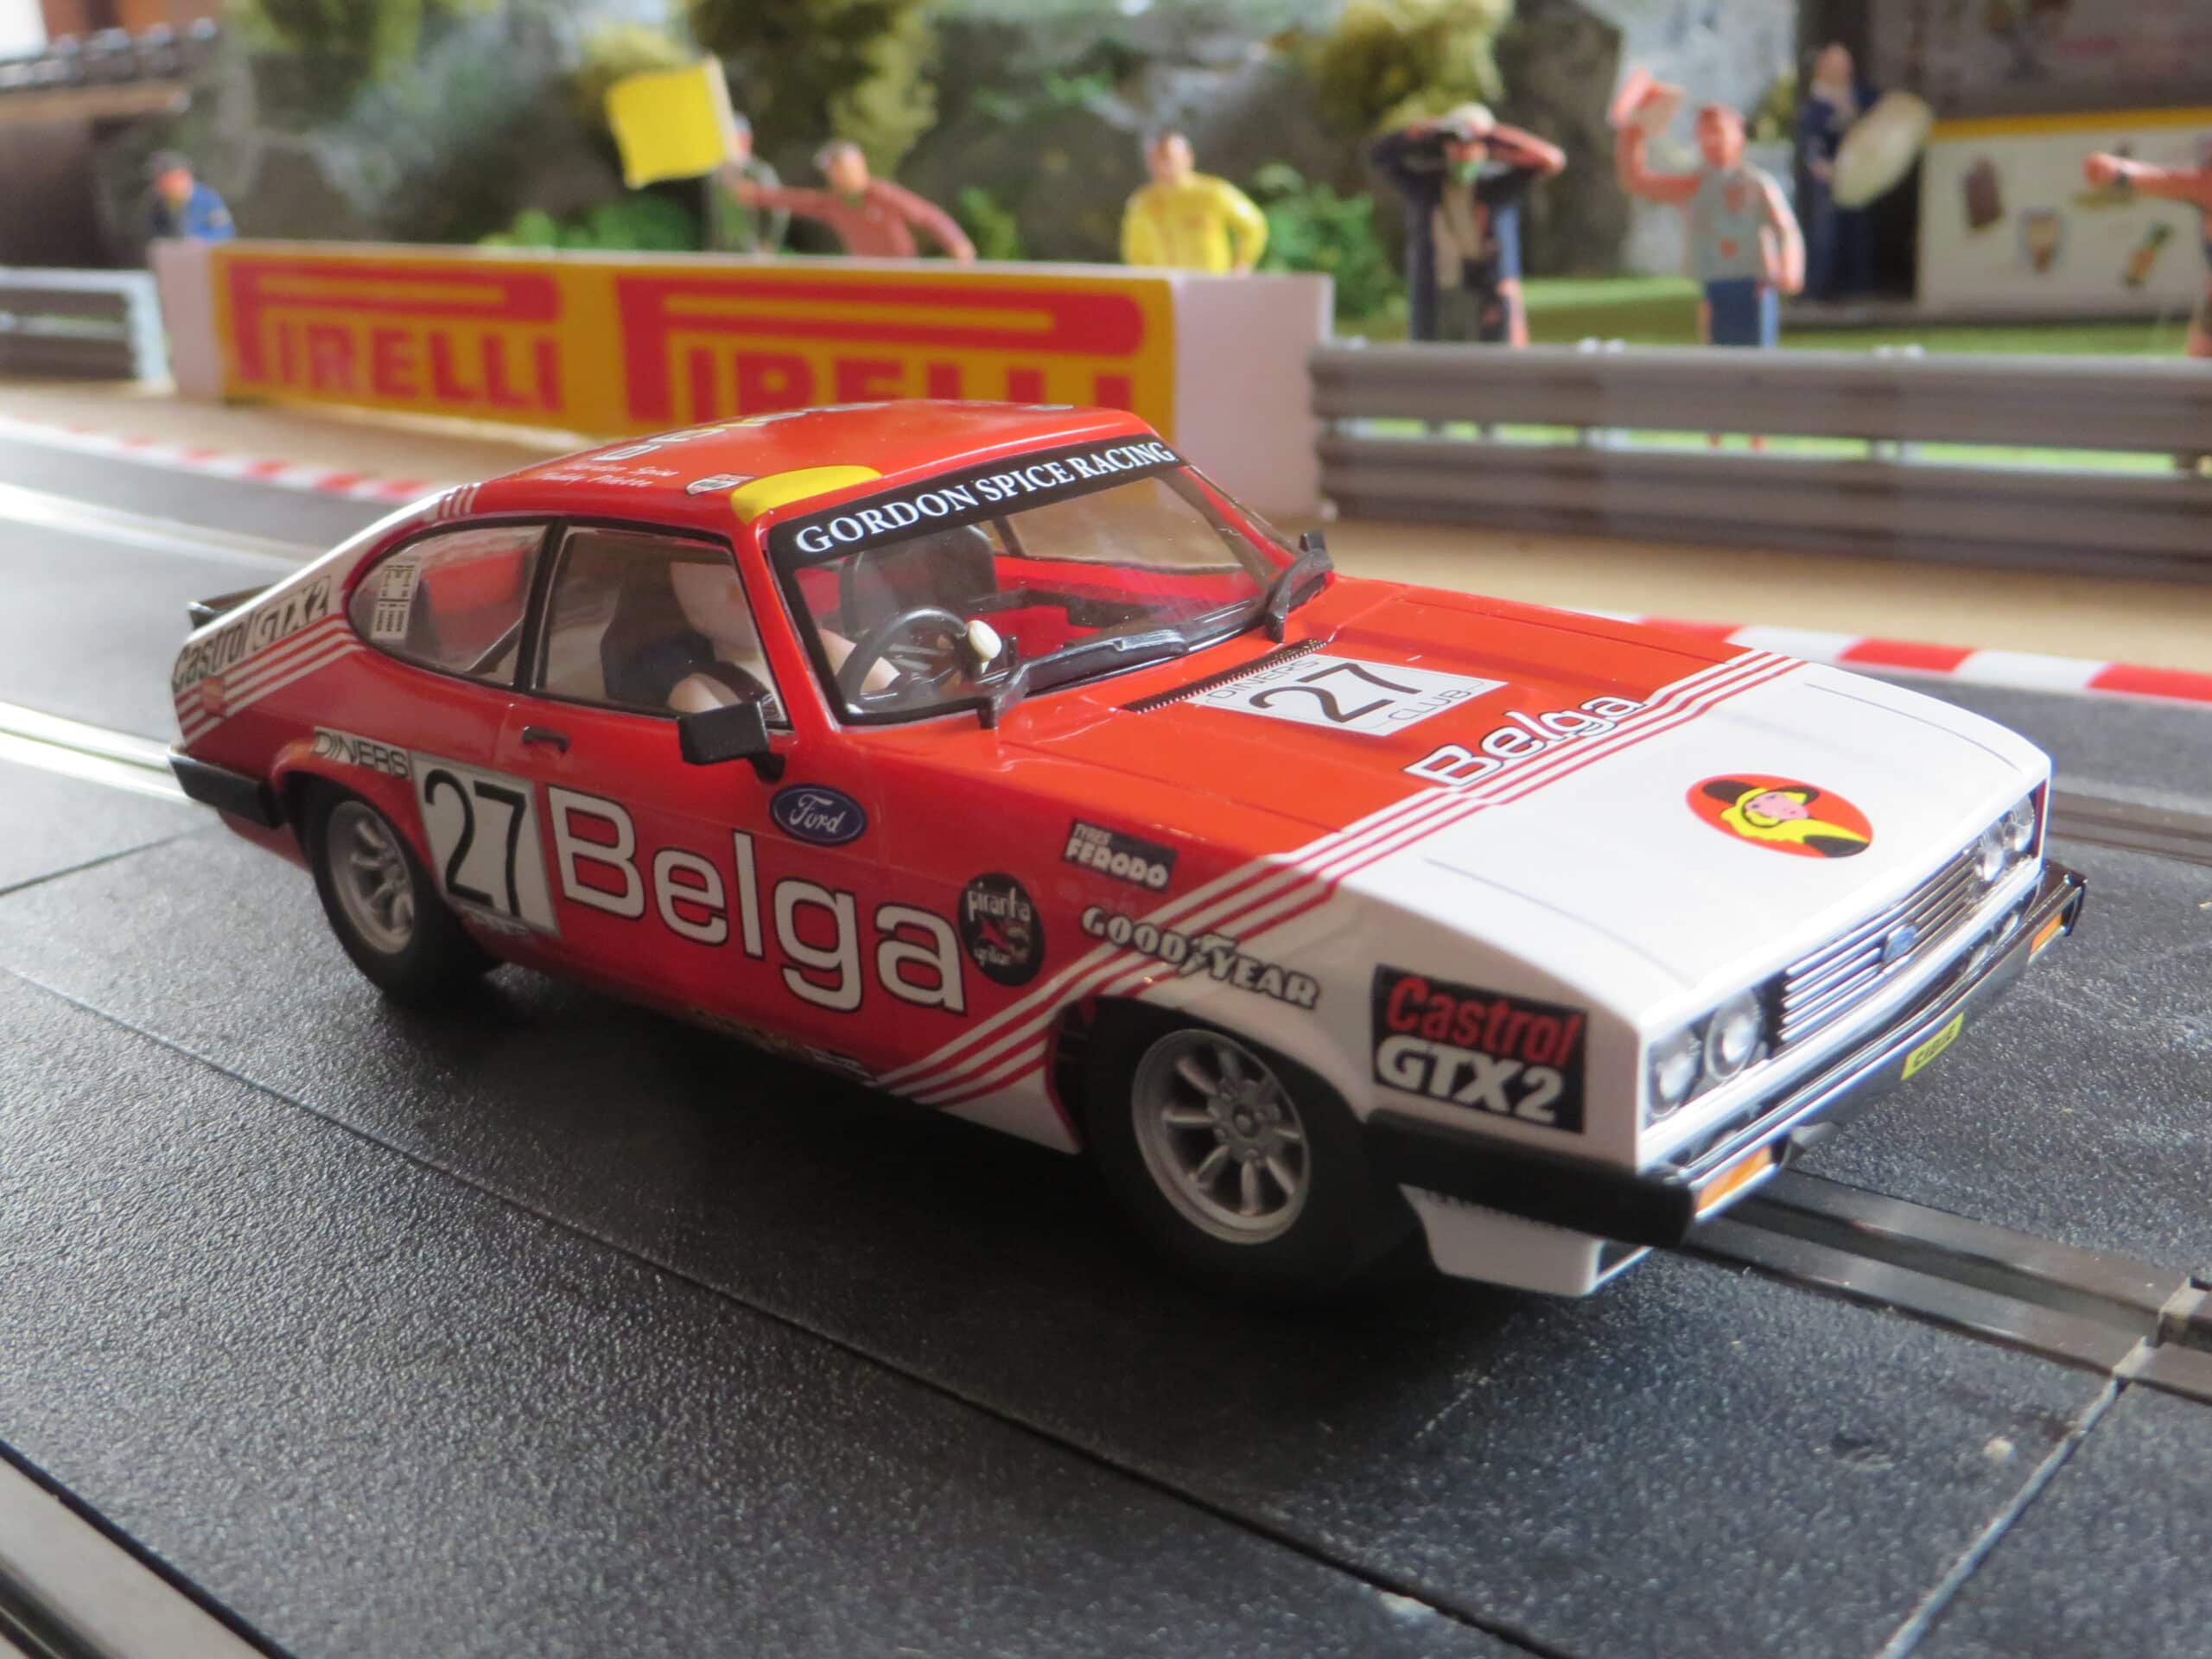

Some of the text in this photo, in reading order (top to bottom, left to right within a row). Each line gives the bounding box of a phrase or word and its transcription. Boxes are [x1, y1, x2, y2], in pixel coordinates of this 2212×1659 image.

[229, 262, 562, 415] PIRELLI
[796, 483, 979, 553] GORDON
[975, 461, 1076, 504] SPICE
[1071, 442, 1179, 480] RACING
[1206, 659, 1319, 700] DINERS
[1249, 662, 1423, 723] 27
[1388, 689, 1472, 721] CLUB
[312, 731, 410, 779] DINERS
[1401, 696, 1647, 787] Belga
[424, 768, 527, 918] 27
[789, 792, 847, 835] Ford
[548, 785, 968, 1015] Belga
[1065, 836, 1169, 888] FERODO
[1081, 906, 1320, 1010] GOODYEAR
[1385, 976, 1583, 1067] Castrol
[1376, 1033, 1566, 1124] GTX2
